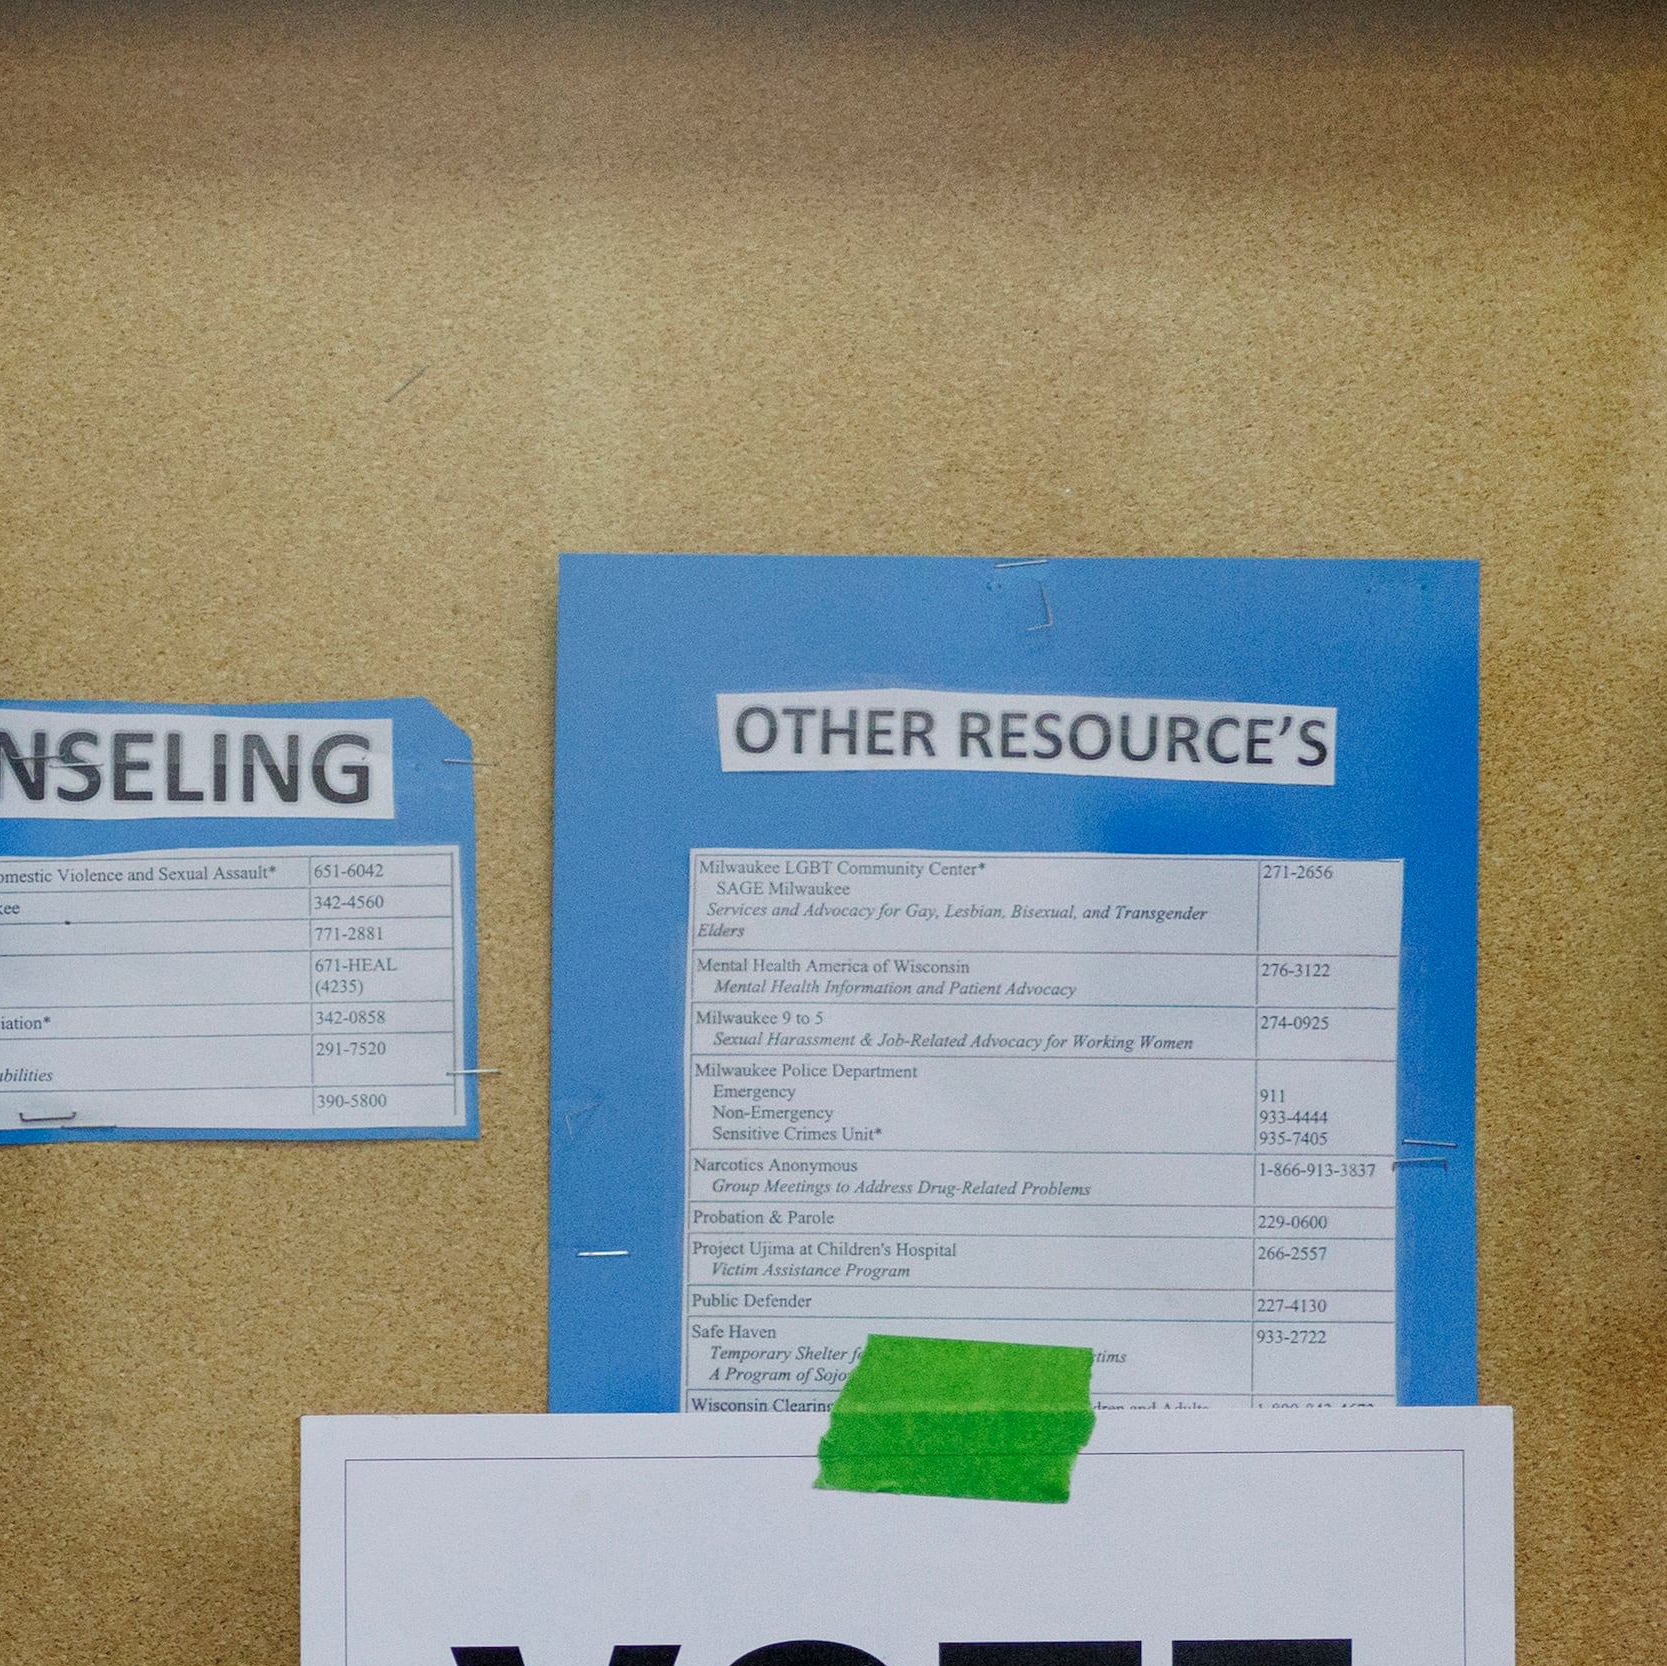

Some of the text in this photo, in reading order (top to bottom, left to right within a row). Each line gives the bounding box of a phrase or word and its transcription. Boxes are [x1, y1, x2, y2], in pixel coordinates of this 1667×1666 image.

[734, 706, 936, 757] OTHER
[959, 711, 1328, 768] RESOURCE'S
[56, 868, 124, 883] Violence
[127, 866, 155, 882] and
[158, 865, 209, 882] Sexual
[313, 863, 384, 879] 651-6042
[698, 859, 783, 877] Milwaukee
[785, 859, 833, 875] LGBT
[836, 860, 925, 879] Community
[1262, 863, 1335, 882] 271-2656
[314, 956, 400, 974] 671-HEAL
[316, 1009, 388, 1027] 342-0858
[317, 1093, 390, 1111] 390-5800
[1259, 1161, 1378, 1179] 1-866-913-3837
[692, 1209, 835, 1227] Probation & Parole
[1258, 1214, 1328, 1230] 229-0600
[691, 1293, 813, 1310] Public Defender
